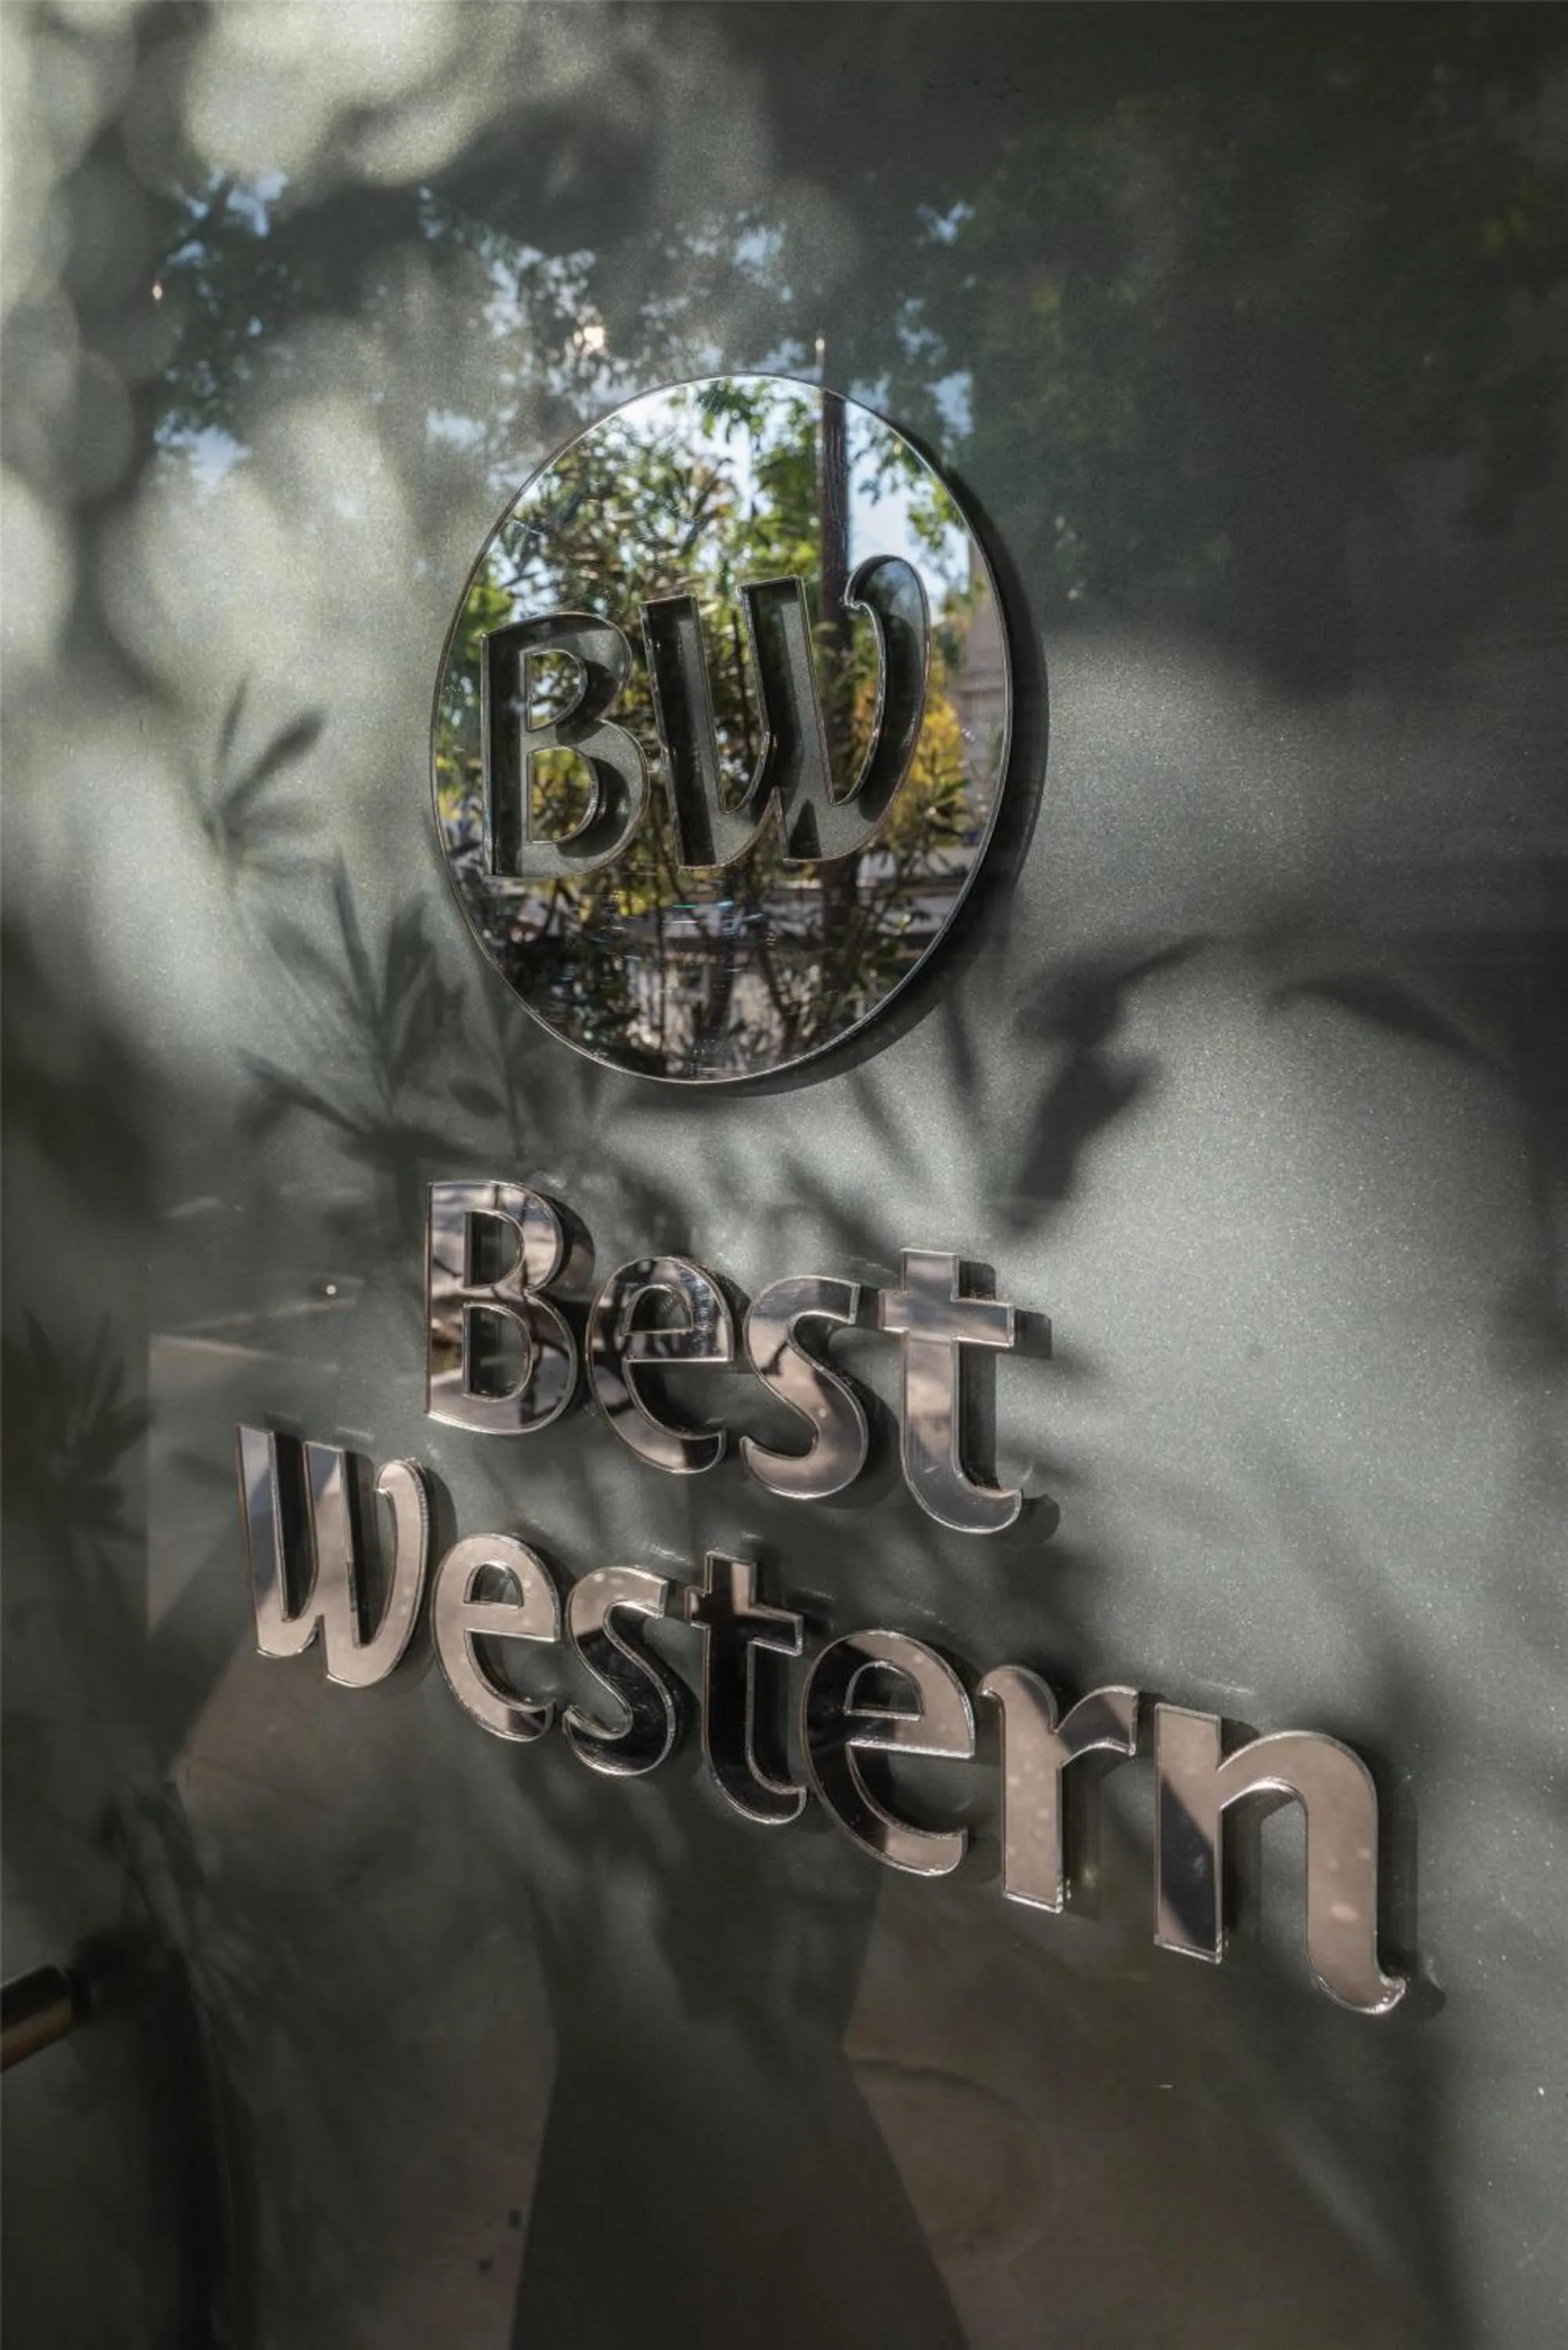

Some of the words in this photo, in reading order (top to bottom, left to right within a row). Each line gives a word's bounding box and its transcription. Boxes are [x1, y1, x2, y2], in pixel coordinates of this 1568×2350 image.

[481, 555, 931, 879] BW
[427, 1179, 1022, 1534] Best
[238, 1425, 1407, 2016] Western
